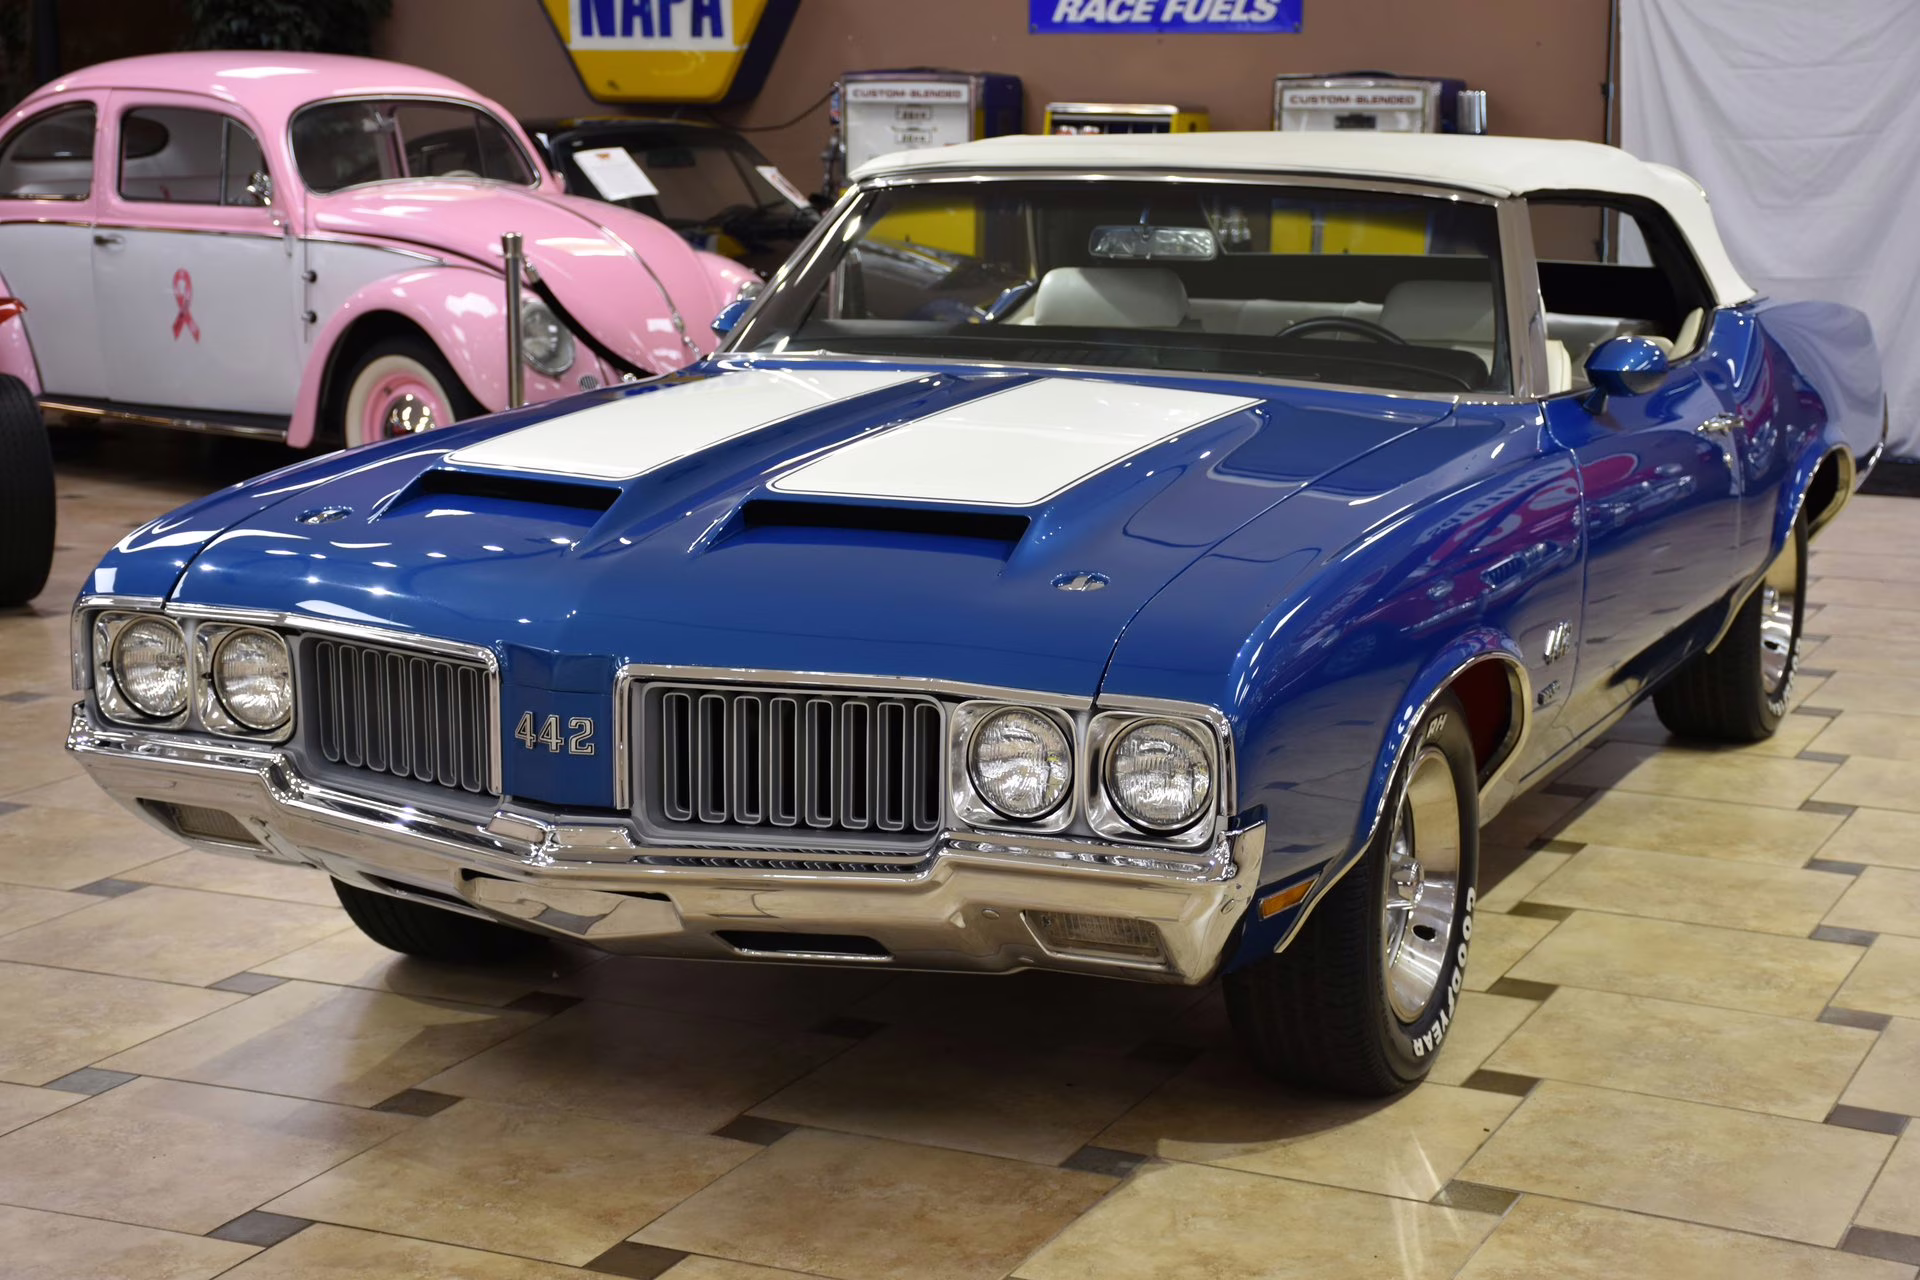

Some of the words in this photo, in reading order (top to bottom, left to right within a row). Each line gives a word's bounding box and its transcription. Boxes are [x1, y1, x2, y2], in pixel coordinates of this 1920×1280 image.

[1052, 0, 1153, 23] RACE
[1160, 0, 1282, 23] FUELS
[515, 710, 595, 756] 442
